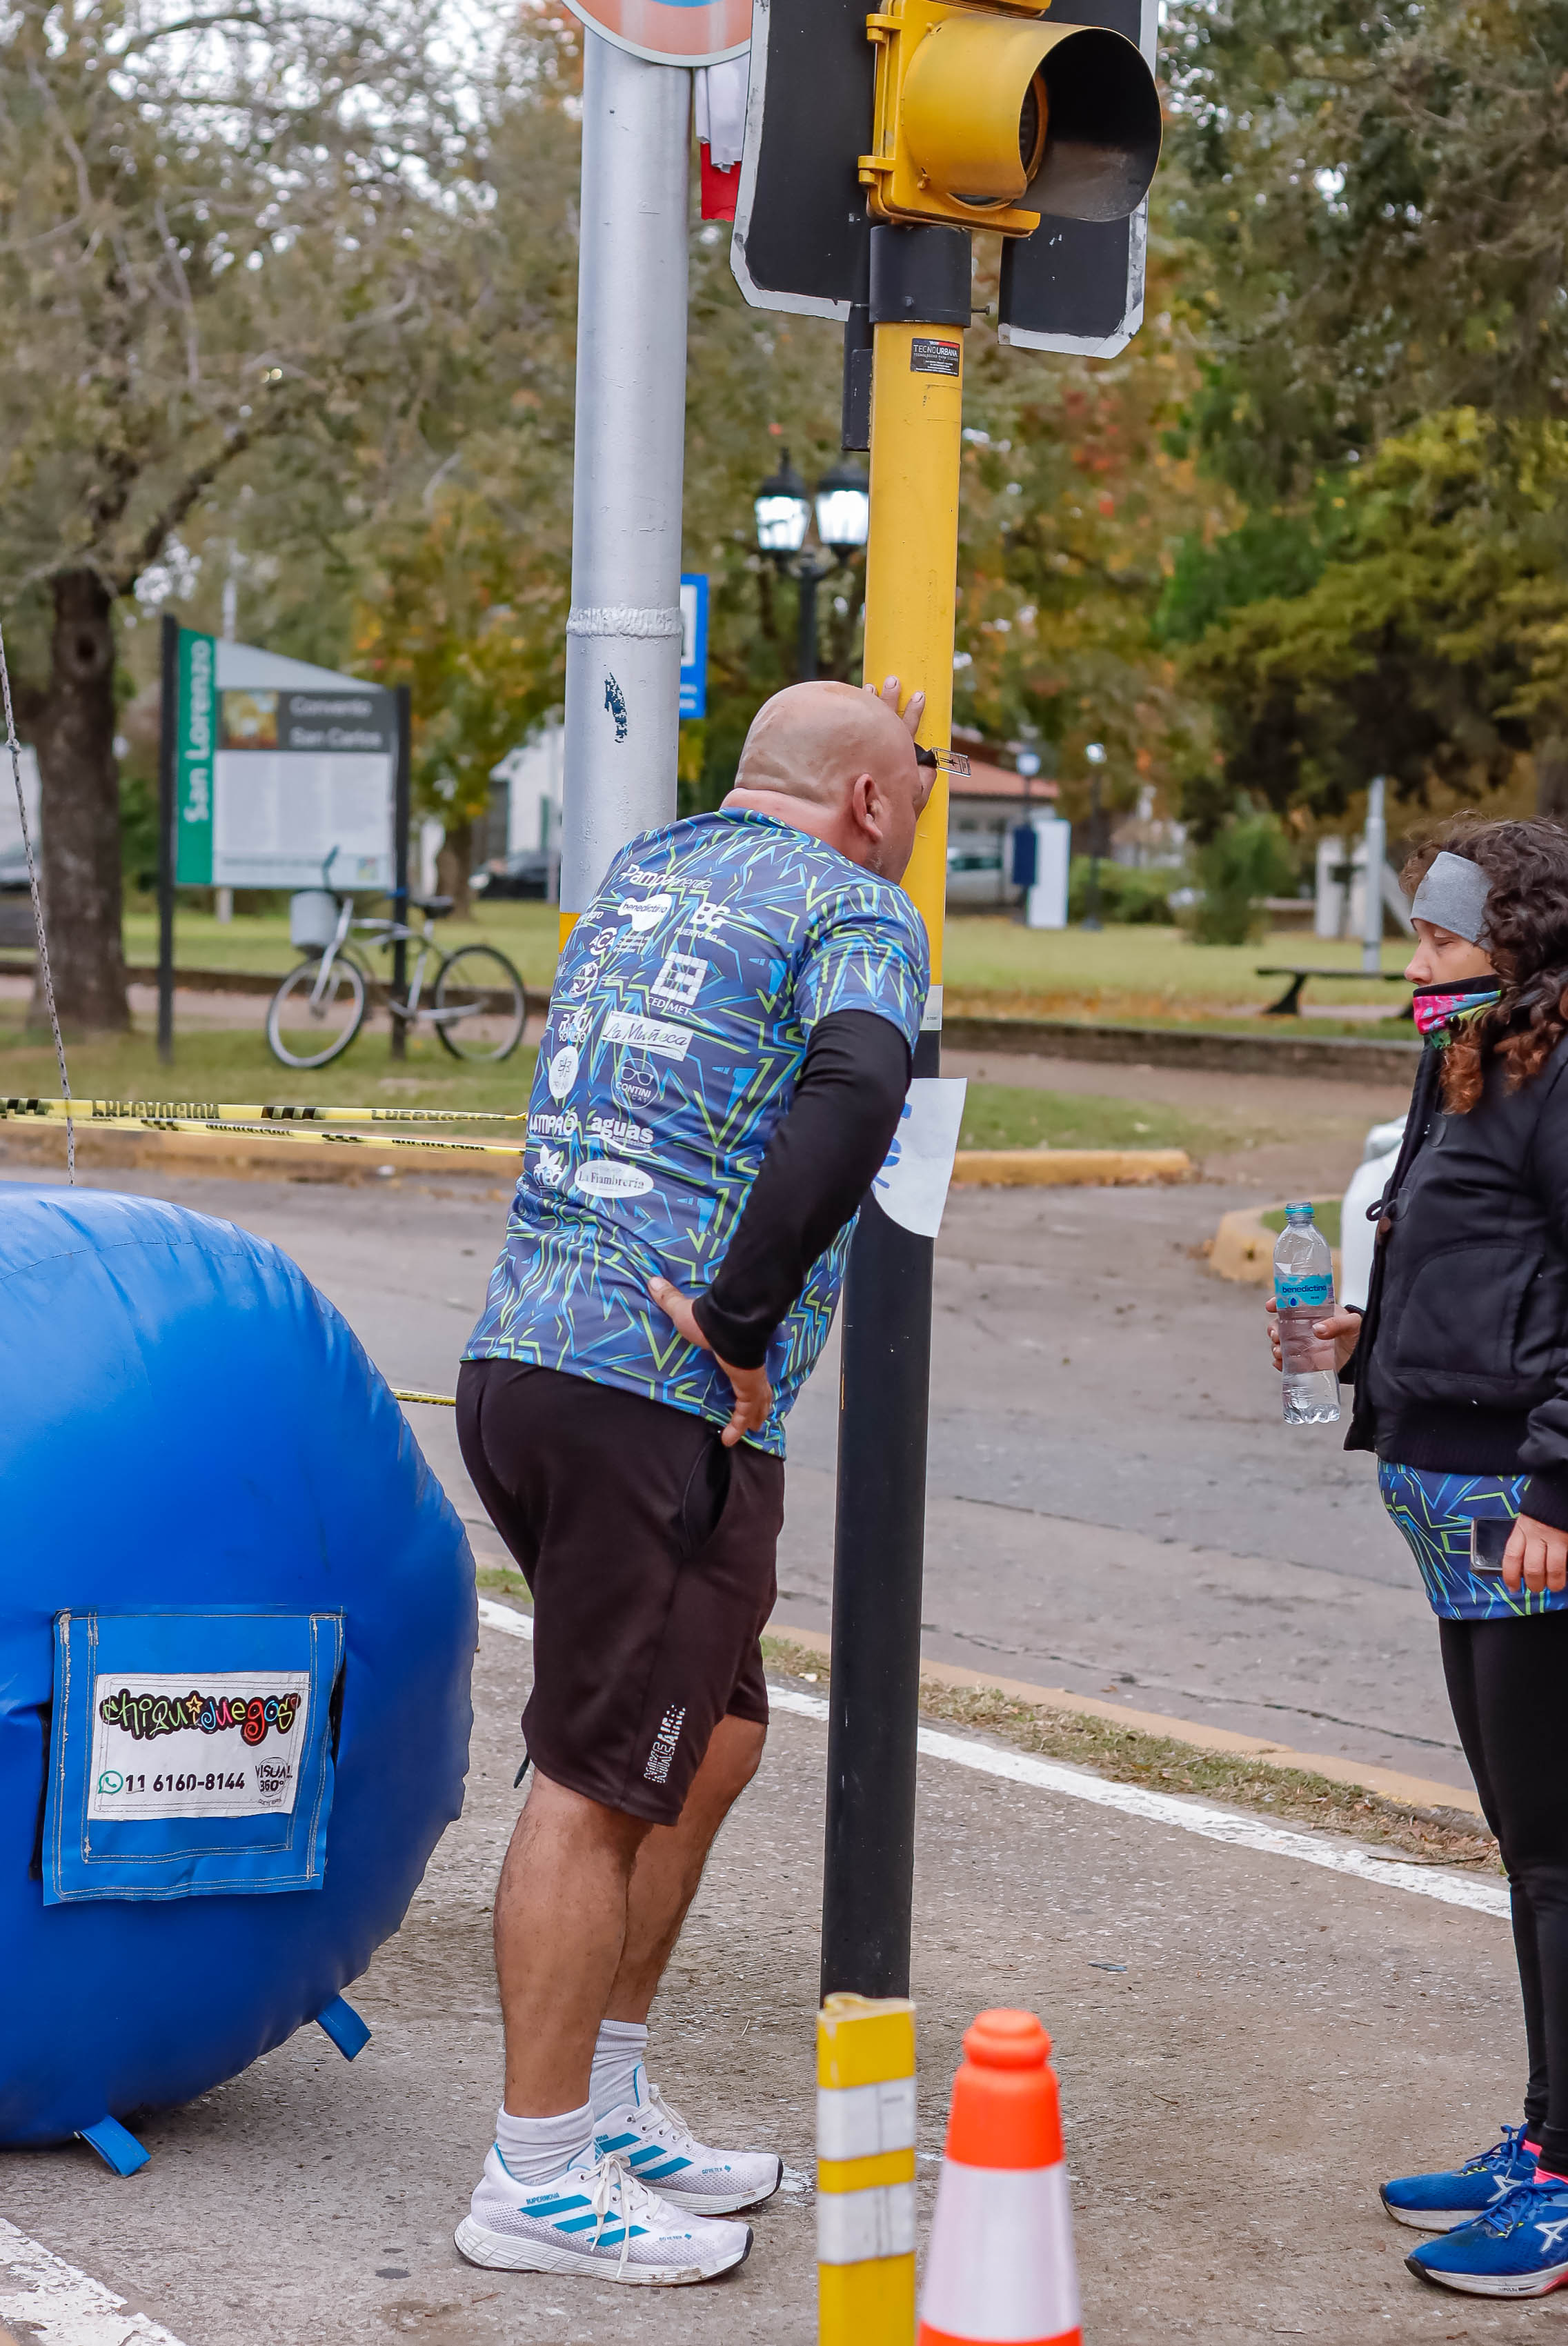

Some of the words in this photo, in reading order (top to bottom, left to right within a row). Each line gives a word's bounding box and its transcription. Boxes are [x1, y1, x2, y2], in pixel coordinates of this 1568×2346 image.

[913, 345, 957, 357] TECNOURBANA
[185, 639, 212, 761] Lorenzo
[183, 768, 210, 824] San
[619, 864, 676, 888] Pampa
[622, 902, 668, 913] benedictino
[689, 901, 731, 928] BG
[588, 933, 616, 949] ACA
[673, 926, 704, 939] PUERTO
[645, 996, 692, 1016] CEDIMET
[602, 1022, 622, 1040] La
[622, 1022, 688, 1046] Muñeca
[615, 1081, 652, 1098] CONTINI
[591, 1116, 654, 1144] aguas
[578, 1171, 588, 1182] La
[591, 1171, 645, 1189] Fiambrería
[255, 1765, 293, 1778] VISUAL
[643, 1740, 676, 1784] NIKE
[126, 1774, 146, 1793] 11
[152, 1772, 246, 1792] 6160-8144
